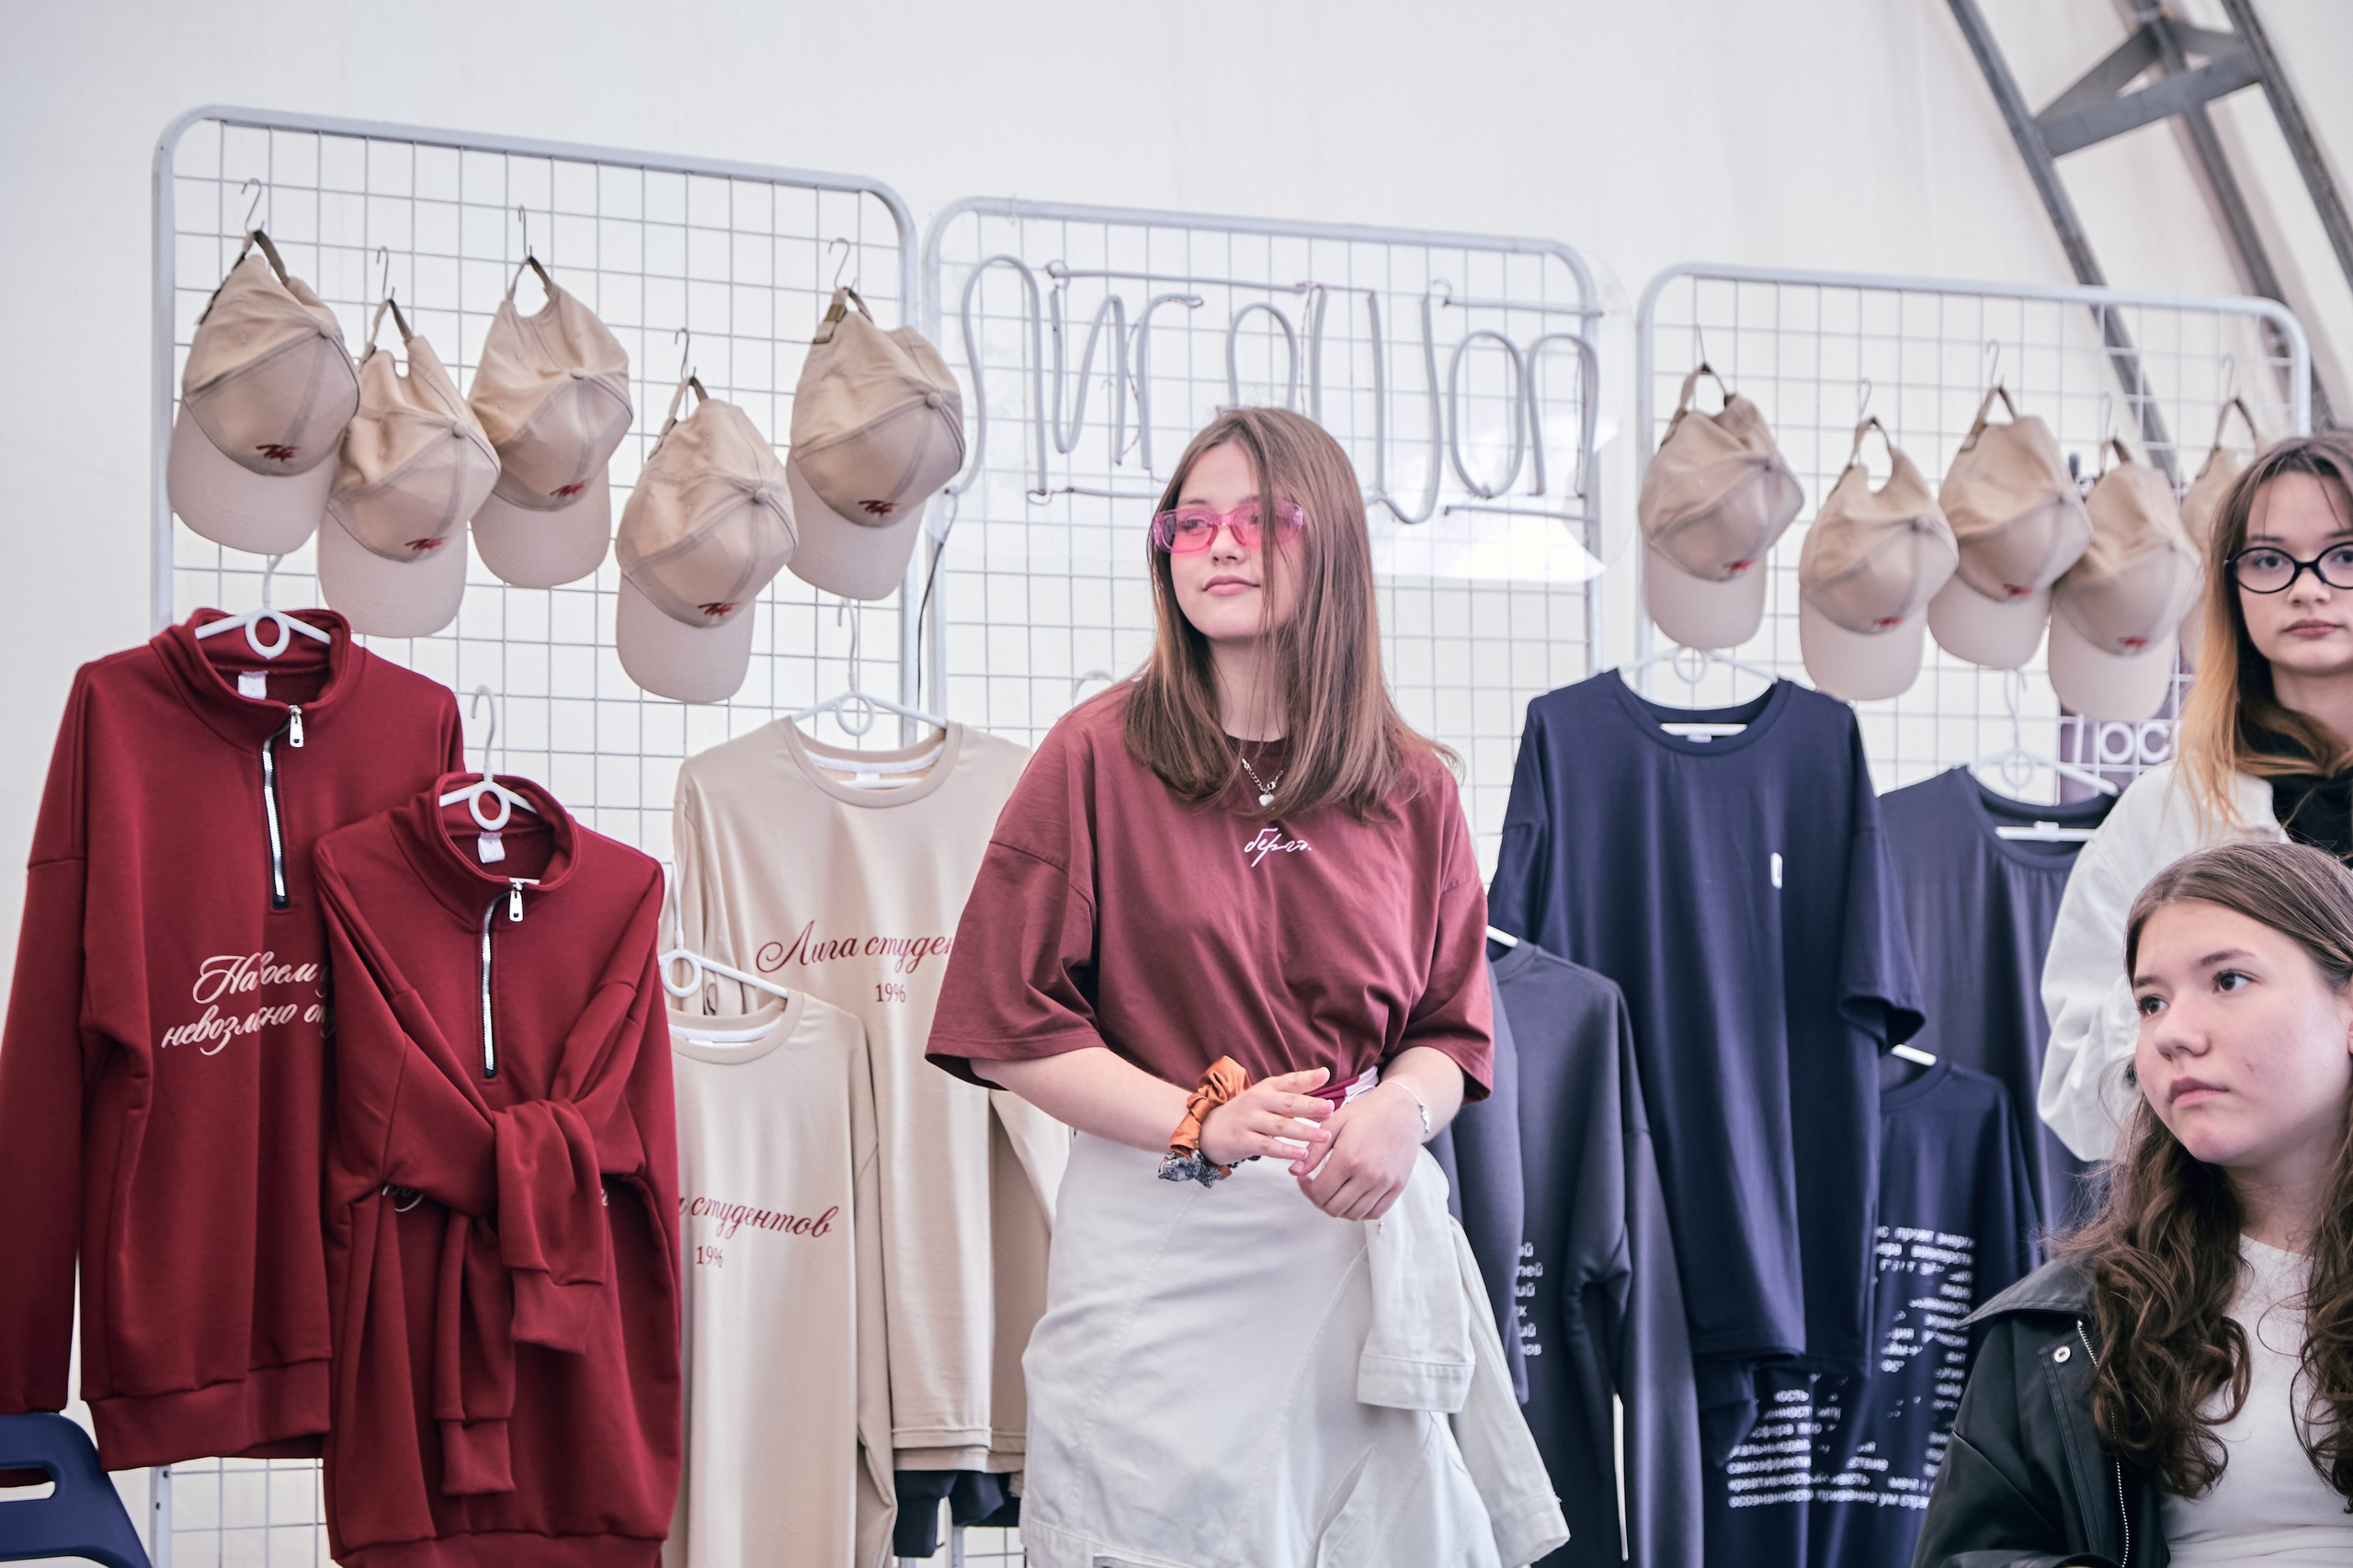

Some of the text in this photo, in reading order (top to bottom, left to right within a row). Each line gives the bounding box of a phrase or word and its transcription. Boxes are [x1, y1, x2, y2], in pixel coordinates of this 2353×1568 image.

[756, 919, 858, 972] Лига
[876, 973, 906, 1003] 1996
[691, 1197, 839, 1240] студентов
